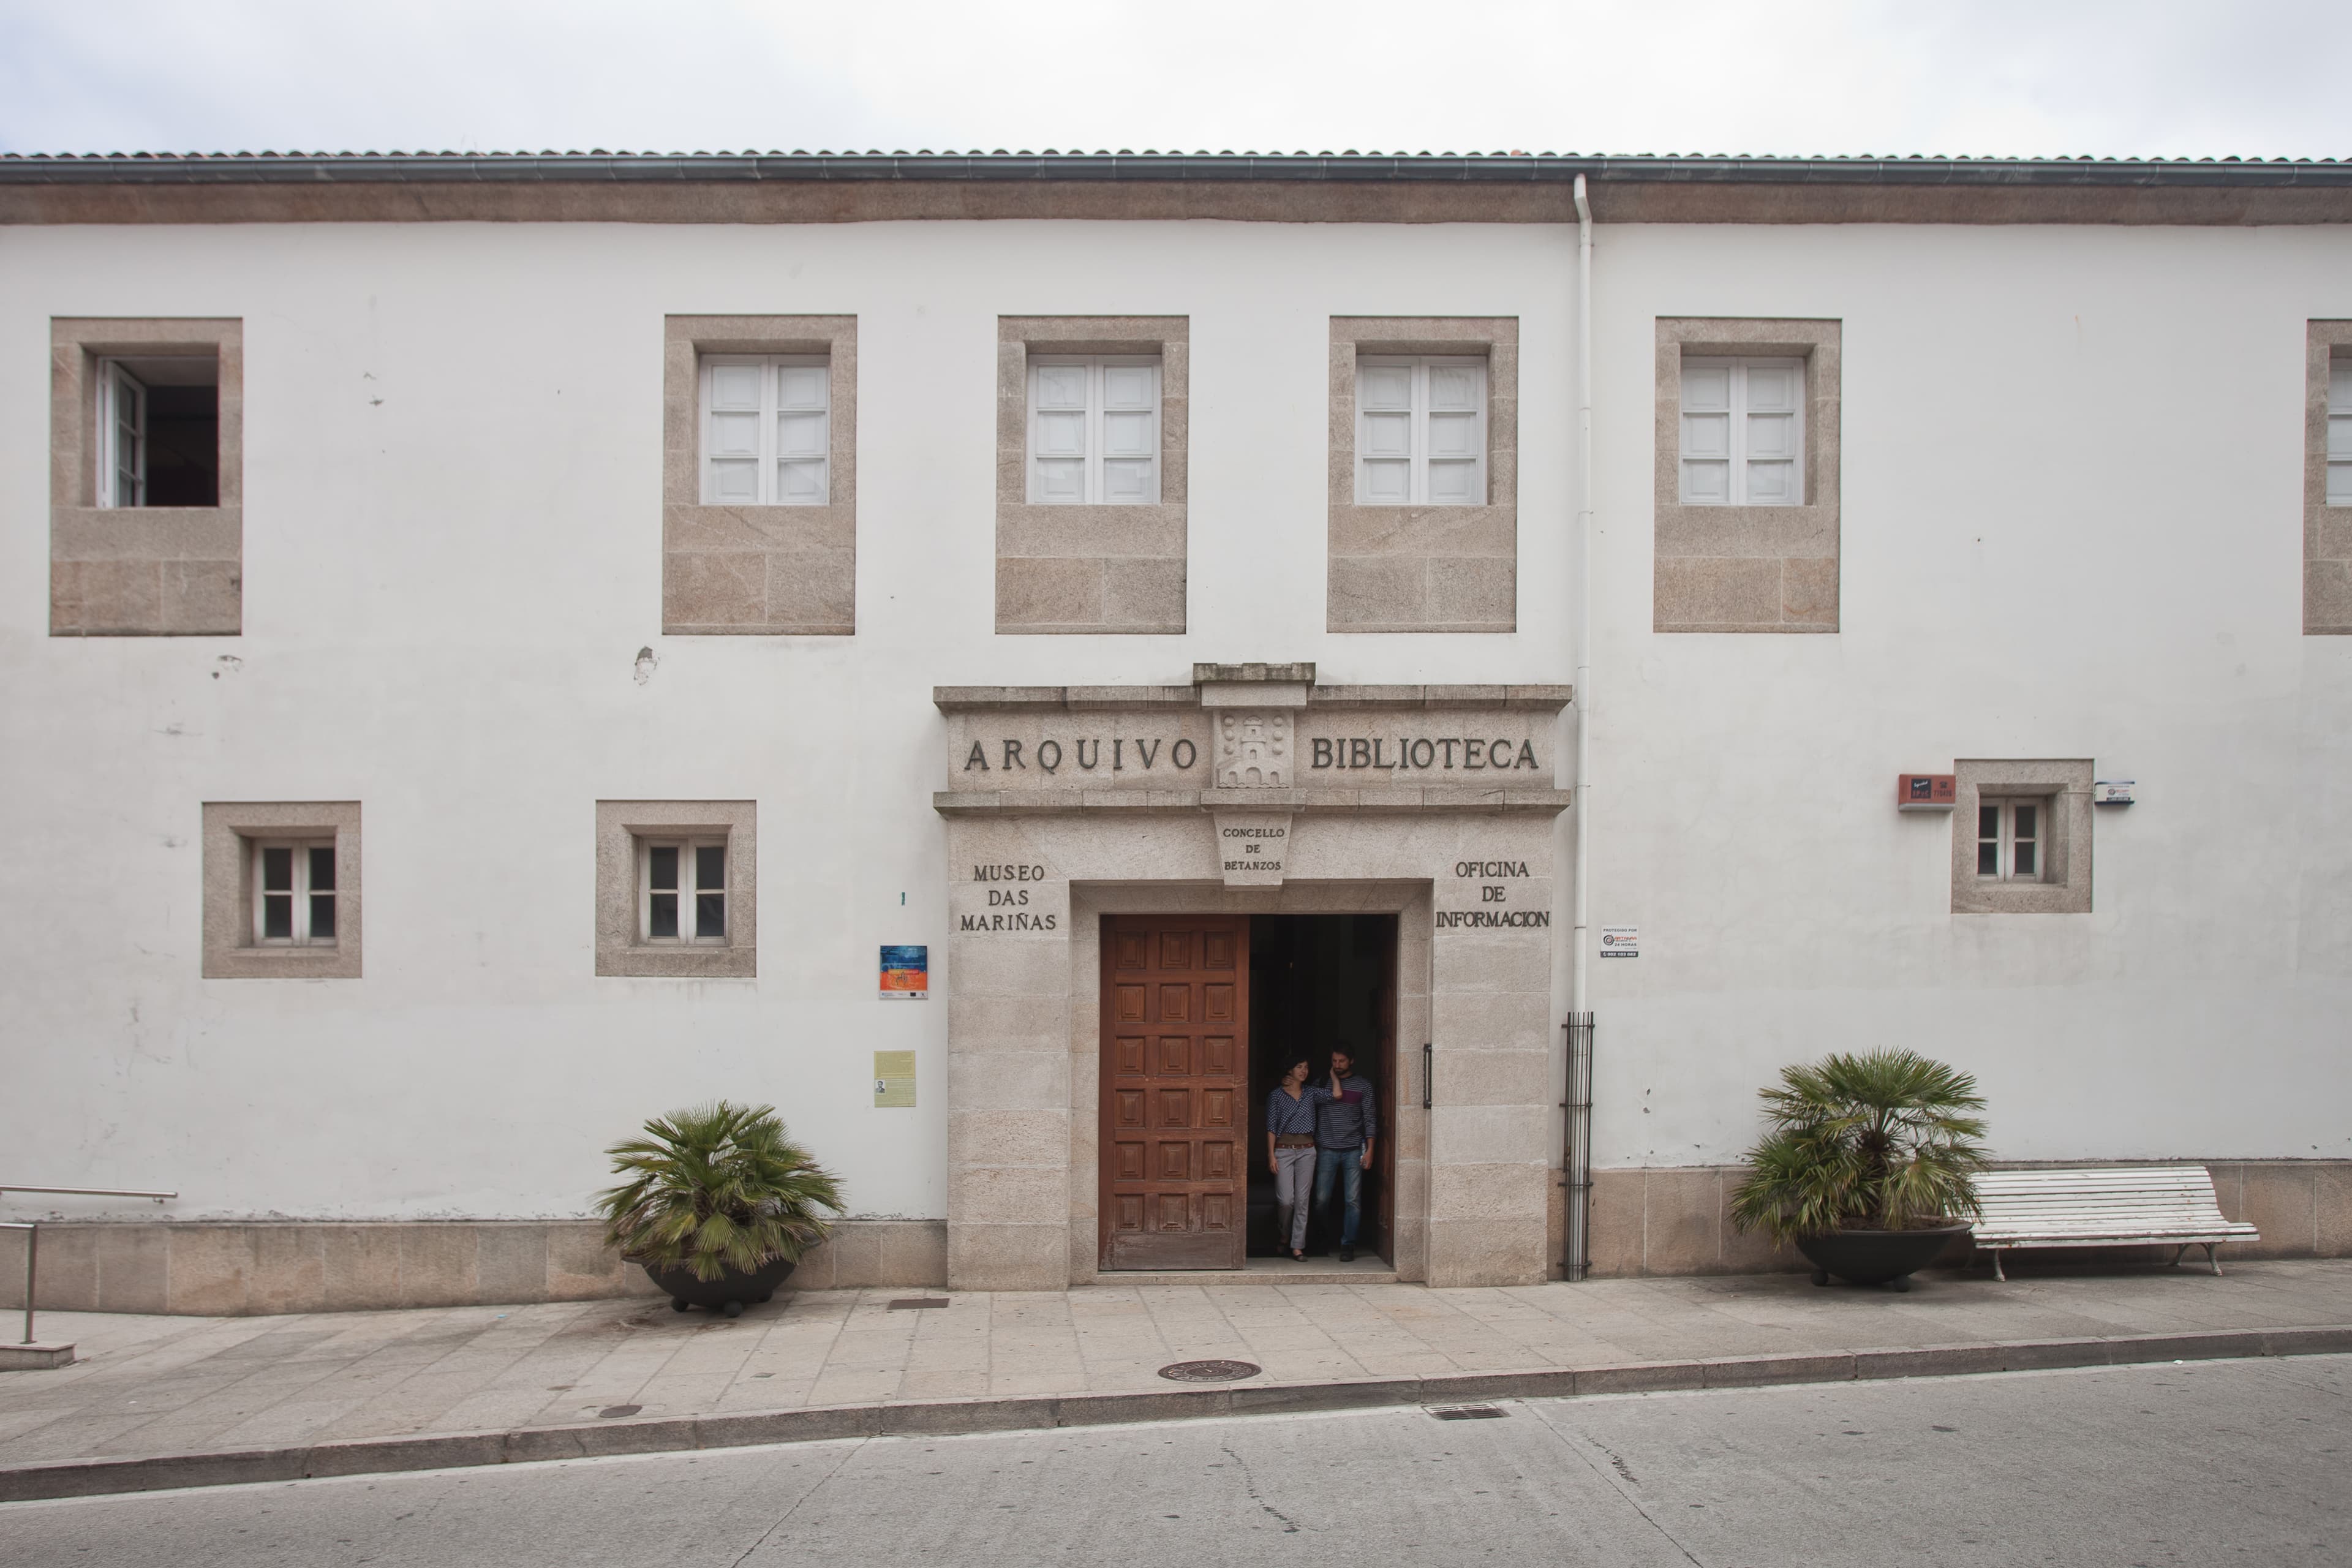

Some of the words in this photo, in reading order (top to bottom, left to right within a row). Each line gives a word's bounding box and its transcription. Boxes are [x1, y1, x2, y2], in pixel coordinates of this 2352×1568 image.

[965, 739, 1197, 774] ARQUIVO
[1311, 738, 1539, 769] BIBLIOTECA
[1223, 828, 1285, 838] CONCELLO
[1245, 844, 1261, 854] DE
[973, 864, 1045, 882] MUSEO
[1224, 861, 1282, 871] BETANZOS
[1455, 861, 1530, 878] OFICINA
[988, 889, 1029, 907] DAS
[1481, 886, 1507, 903] DE
[960, 911, 1056, 931] MARIÑAS
[1435, 911, 1550, 929] INFORMACION
